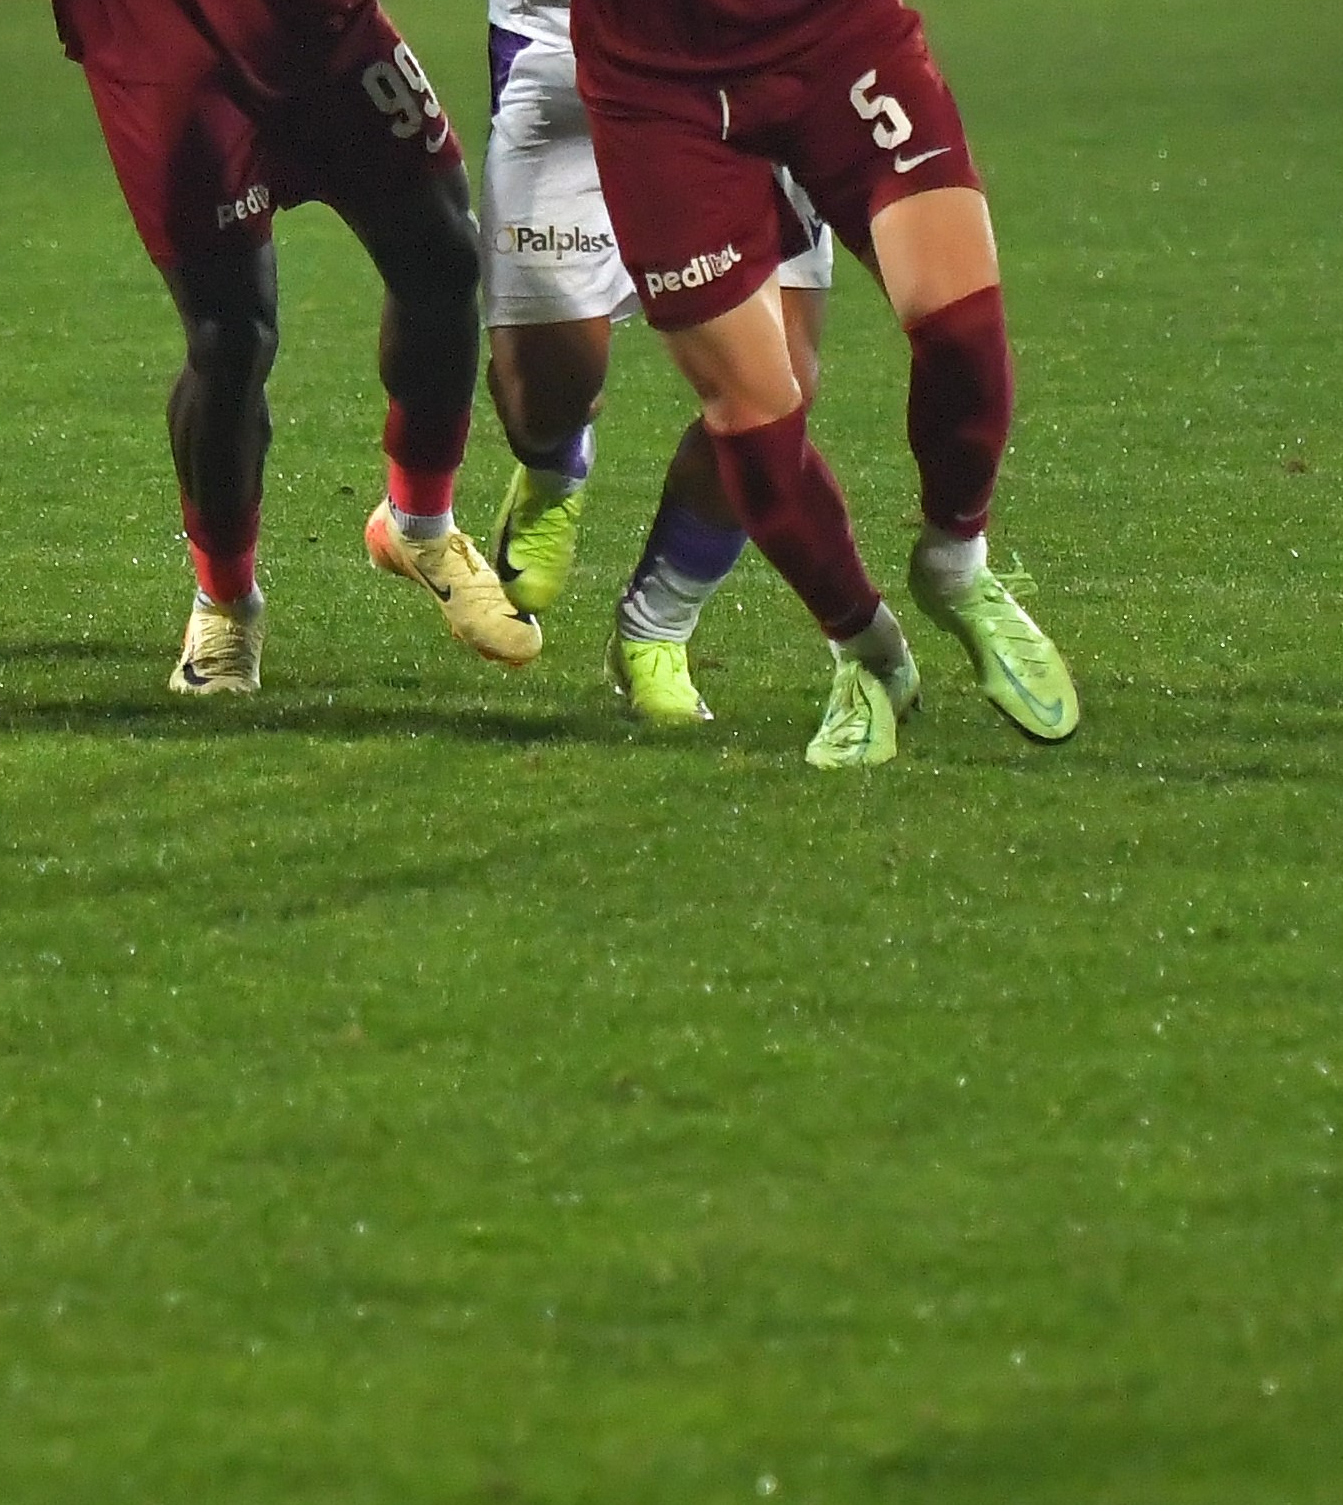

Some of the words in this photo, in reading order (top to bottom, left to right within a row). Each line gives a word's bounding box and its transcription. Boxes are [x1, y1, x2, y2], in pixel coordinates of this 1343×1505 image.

[361, 40, 441, 139] 99
[850, 68, 914, 150] 5
[517, 225, 614, 260] Palplast
[645, 242, 743, 298] peditel
